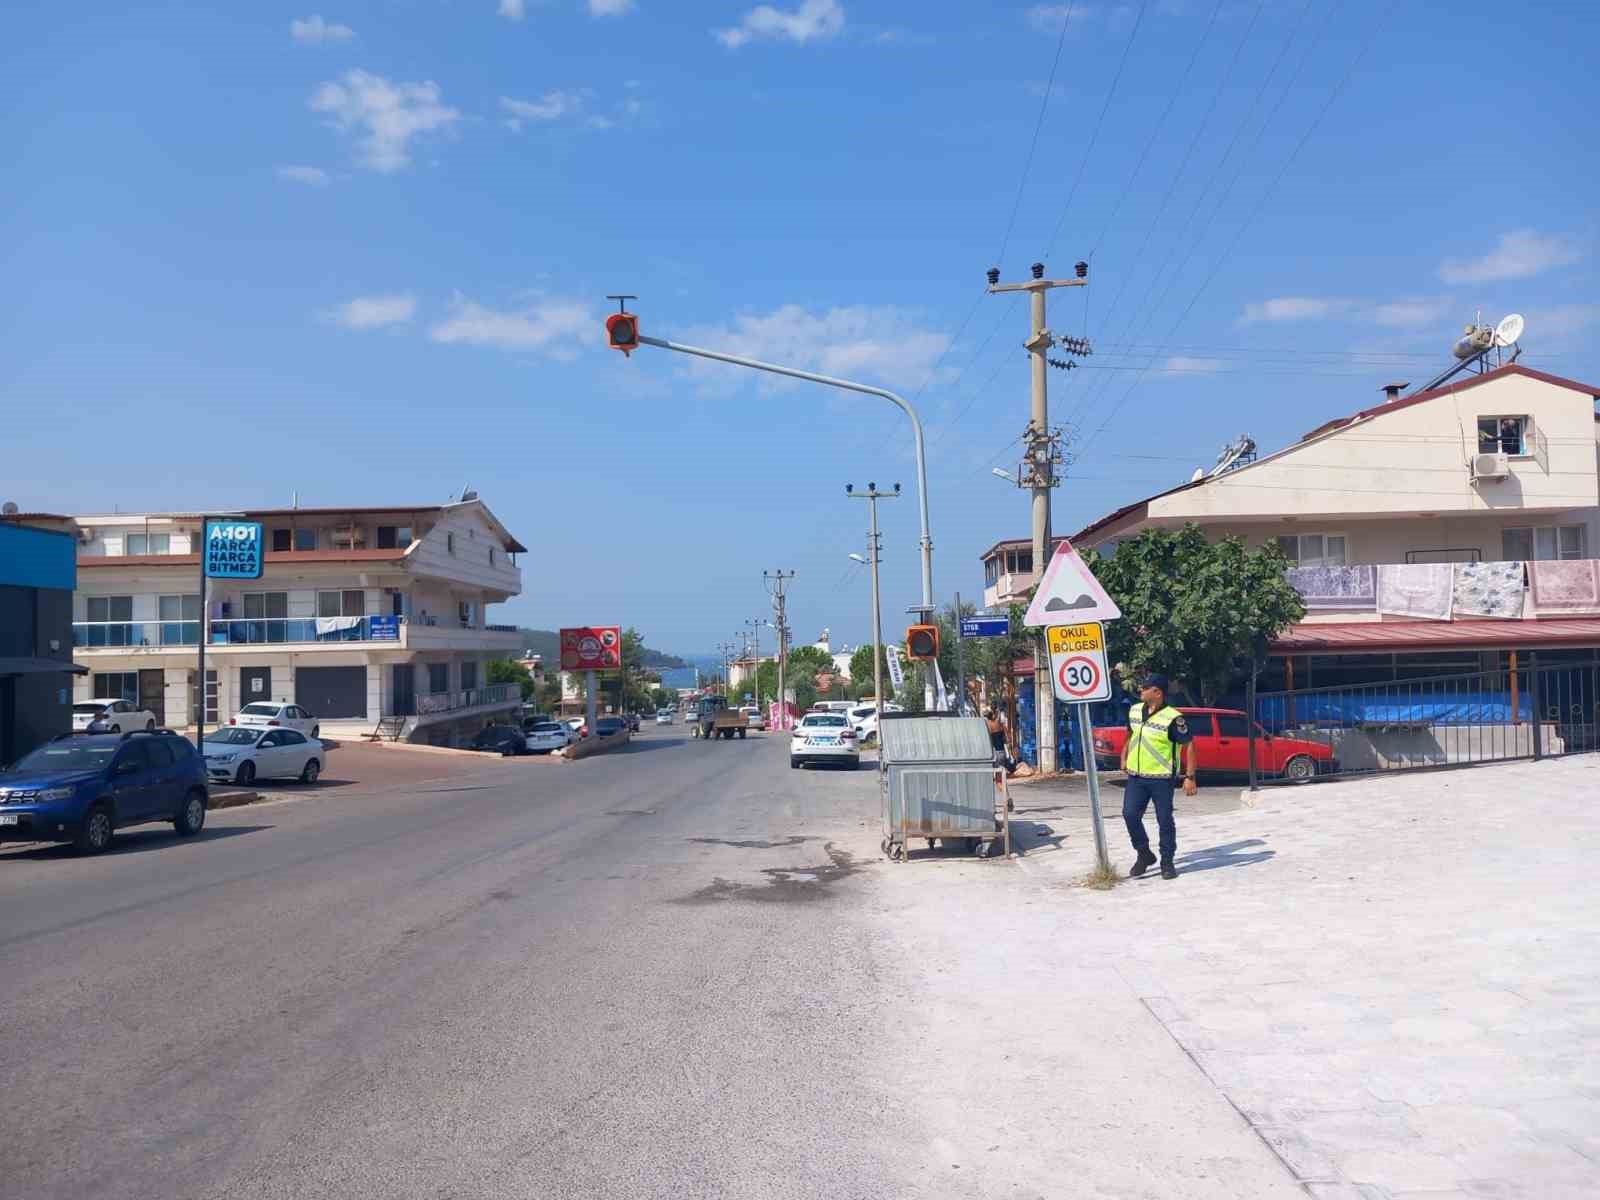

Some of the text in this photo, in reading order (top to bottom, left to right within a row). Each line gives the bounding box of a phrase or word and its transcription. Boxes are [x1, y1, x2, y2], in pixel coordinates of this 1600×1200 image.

[210, 541, 256, 551] HARCA
[210, 552, 256, 562] HARCA
[1060, 627, 1088, 638] OKUL
[1067, 665, 1092, 686] 30
